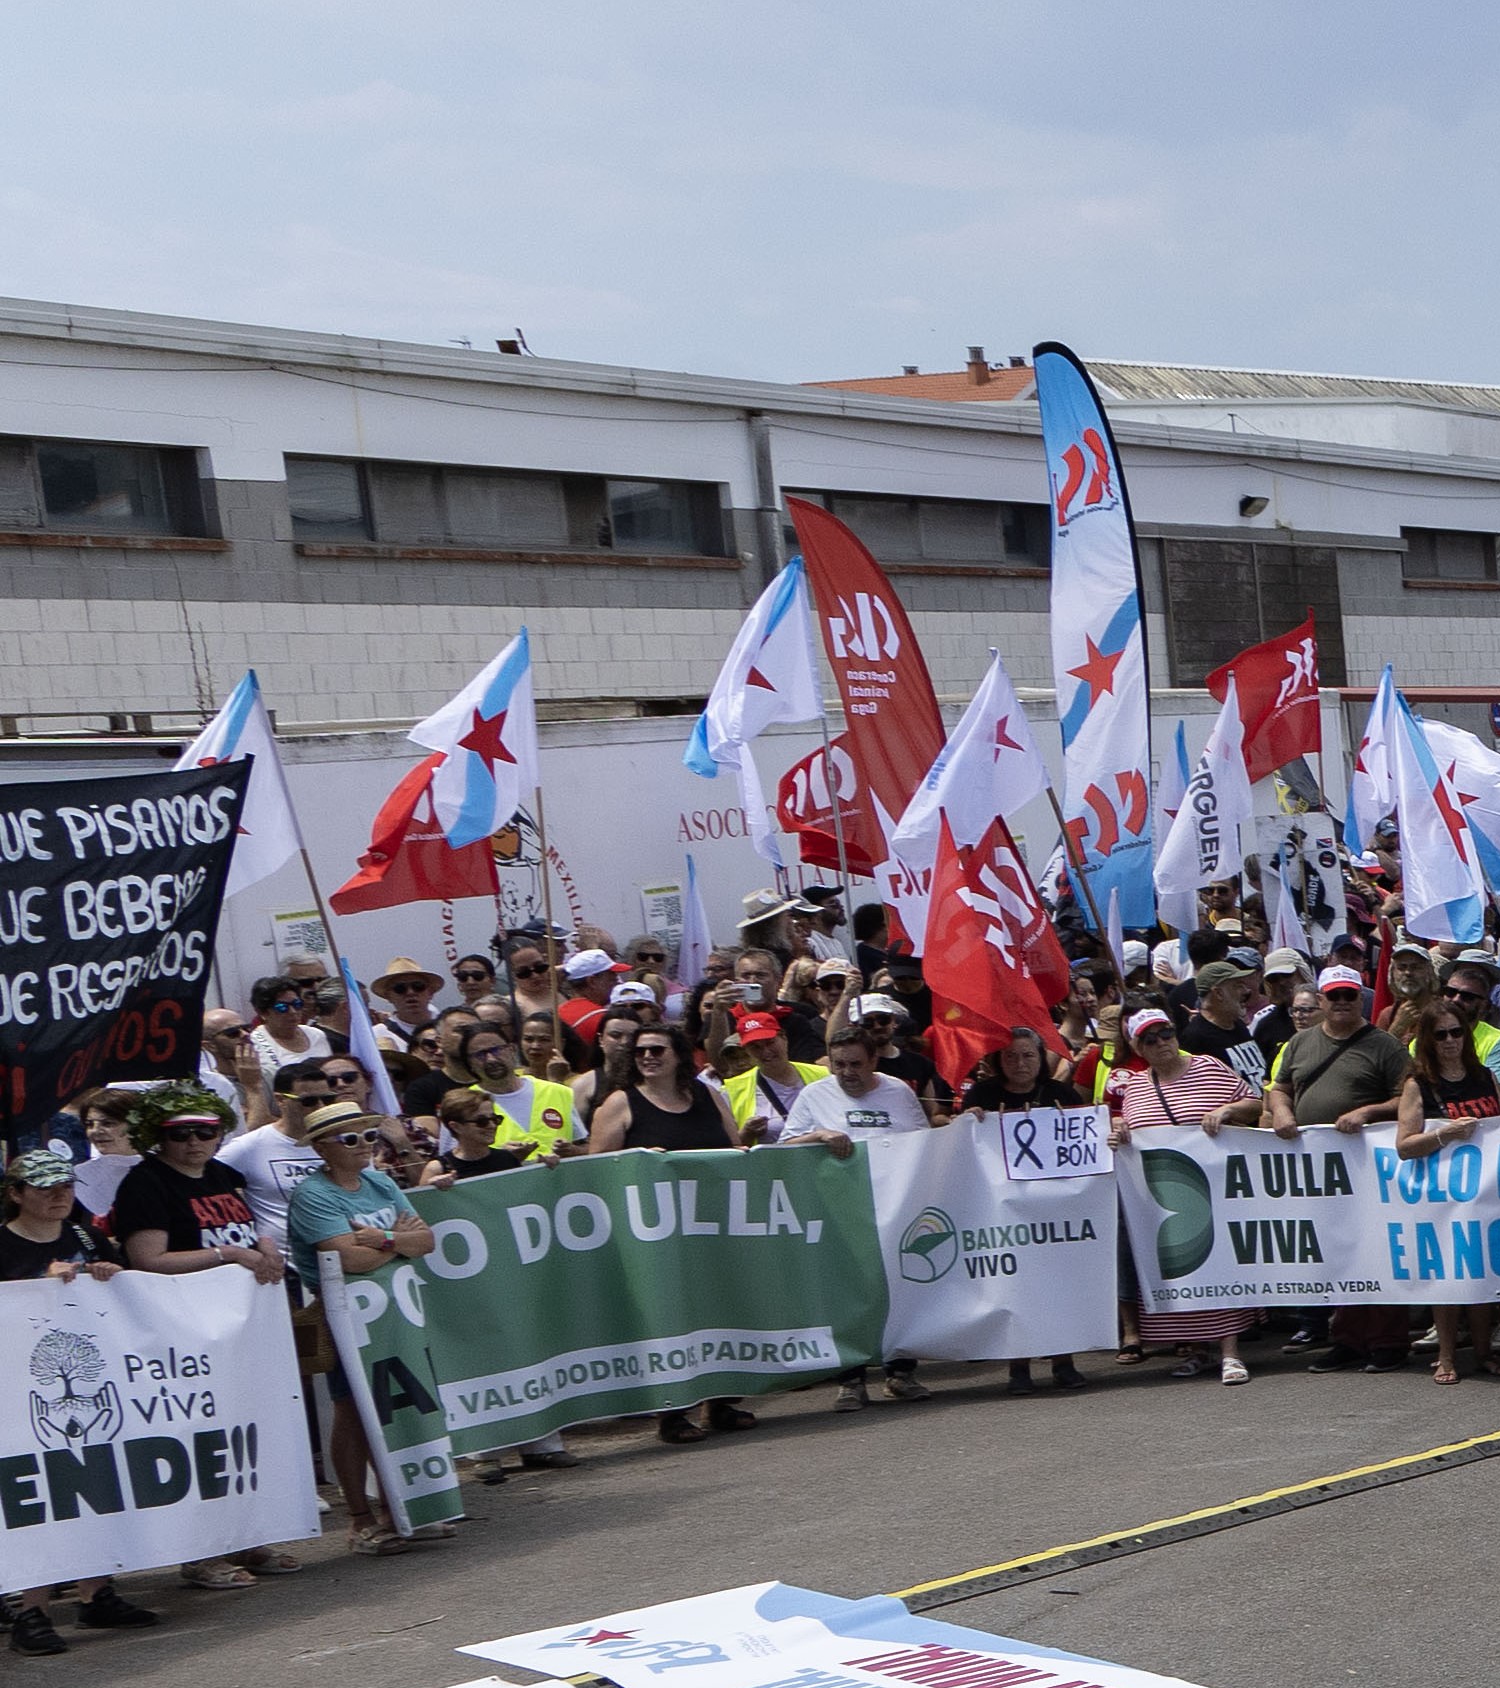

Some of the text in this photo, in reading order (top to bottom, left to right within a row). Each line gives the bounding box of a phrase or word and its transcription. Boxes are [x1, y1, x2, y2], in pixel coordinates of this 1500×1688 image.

[1054, 1115, 1098, 1141] HER
[1056, 1140, 1097, 1167] BÓN
[1224, 1152, 1354, 1199] A ULLA
[1374, 1144, 1483, 1205] POLO
[507, 1178, 824, 1266] DO ULLA,
[961, 1218, 1097, 1252] BAIXOULLA
[1228, 1219, 1324, 1265] VIVA
[964, 1251, 1018, 1280] VIVO
[1387, 1221, 1410, 1281] E
[1415, 1221, 1446, 1281] A
[1262, 1278, 1382, 1295] A ESTRADA VEDRA
[123, 1346, 212, 1383] Palas
[459, 1335, 831, 1416] VALGA, DODRO, PADRÓN.
[130, 1385, 216, 1425] viva
